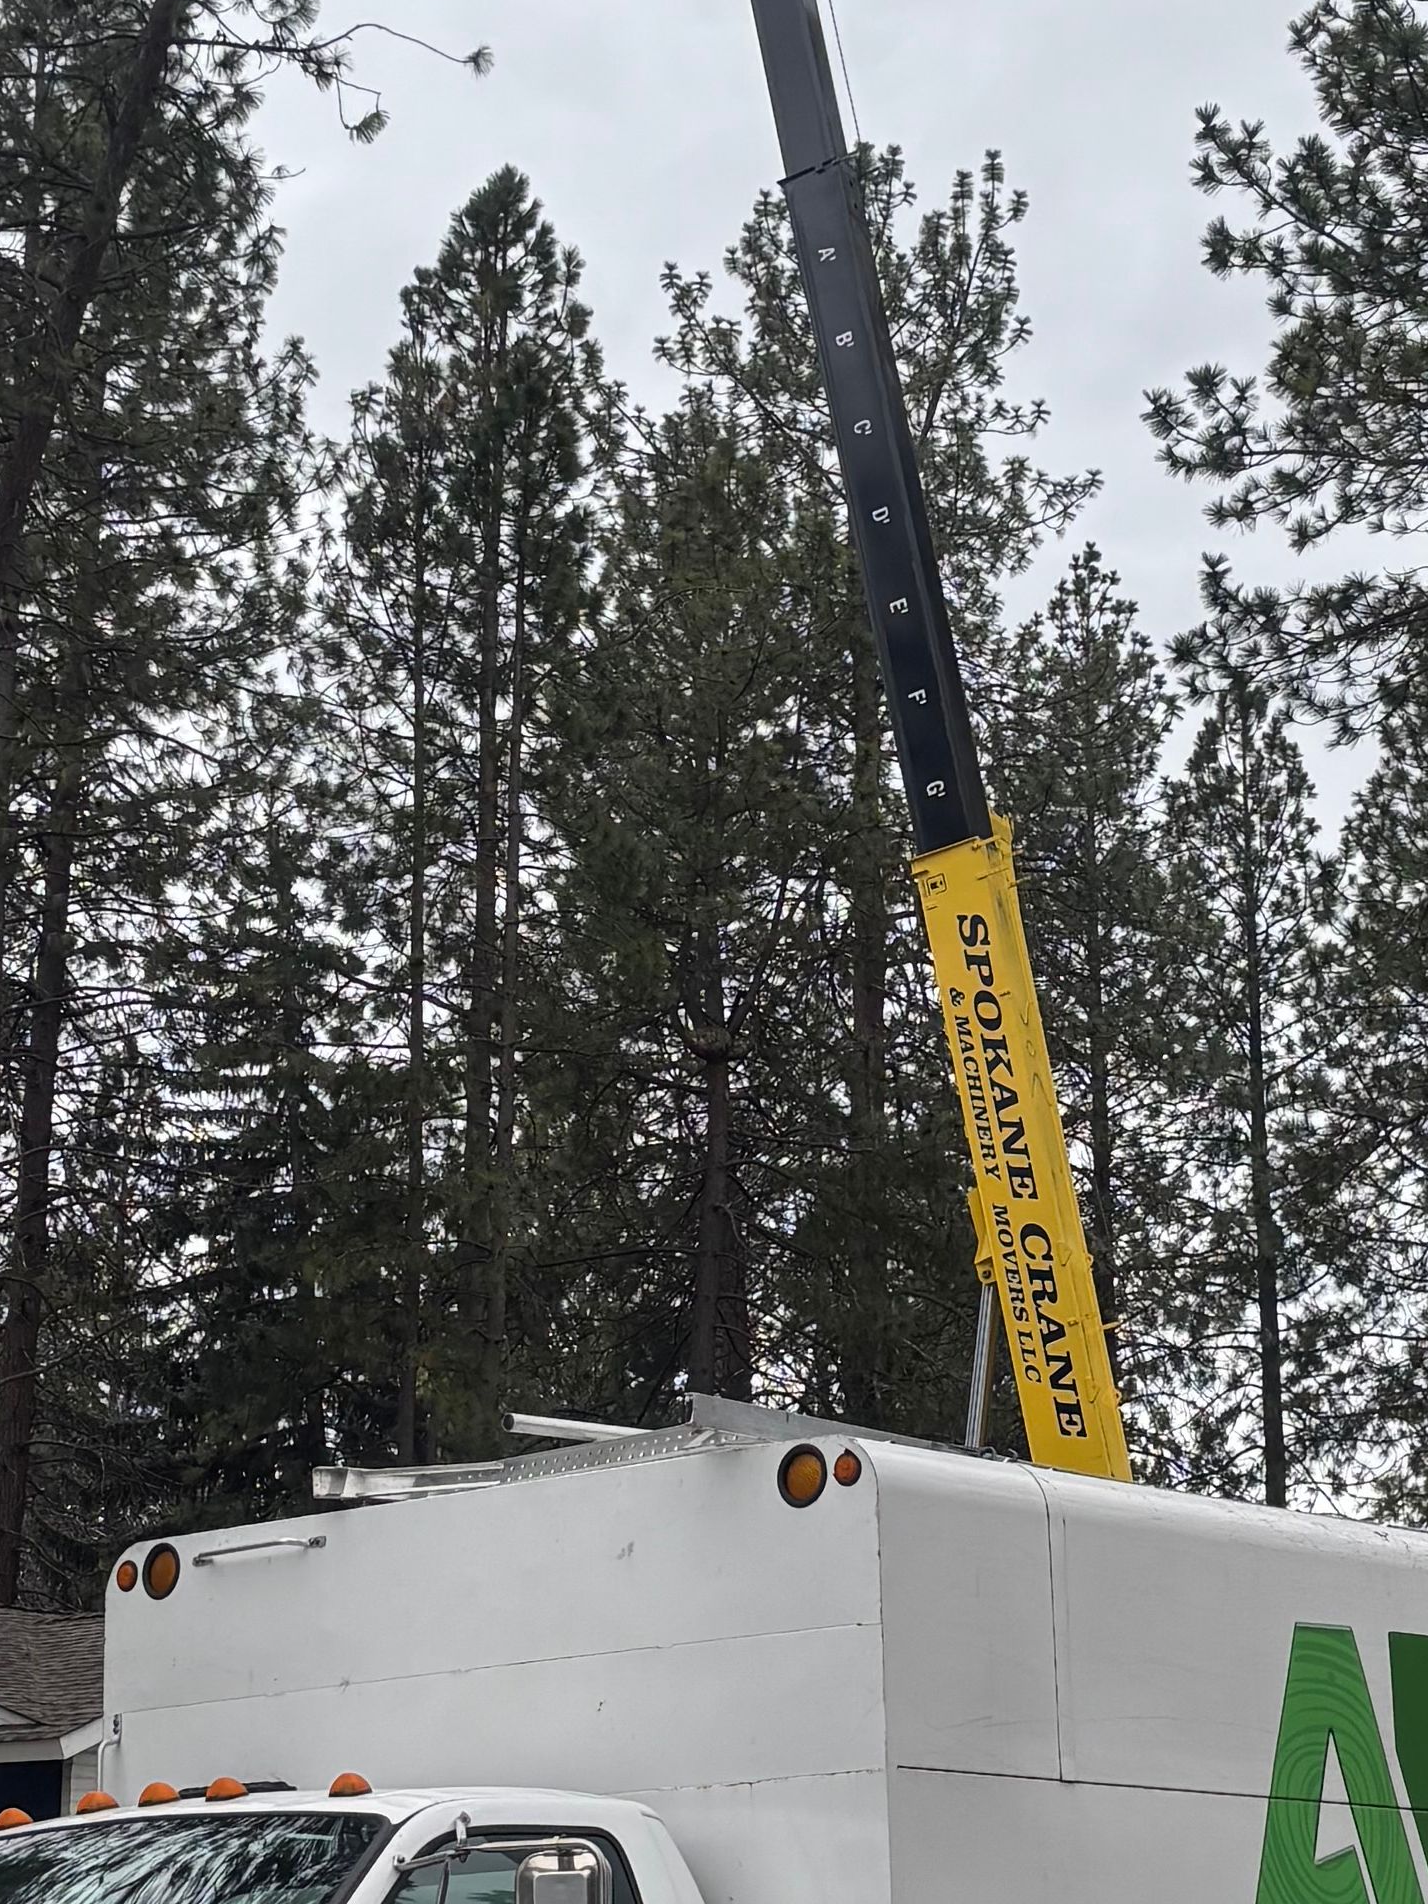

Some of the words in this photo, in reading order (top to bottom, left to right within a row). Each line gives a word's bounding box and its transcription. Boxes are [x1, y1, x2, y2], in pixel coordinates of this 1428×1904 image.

[949, 986, 966, 1007] &
[954, 1015, 1003, 1182] MACHINERY
[956, 914, 1039, 1200] SPOKANE
[1020, 1223, 1088, 1438] CRANE
[992, 1203, 1031, 1323] MOVERS
[1017, 1328, 1042, 1384] LLC
